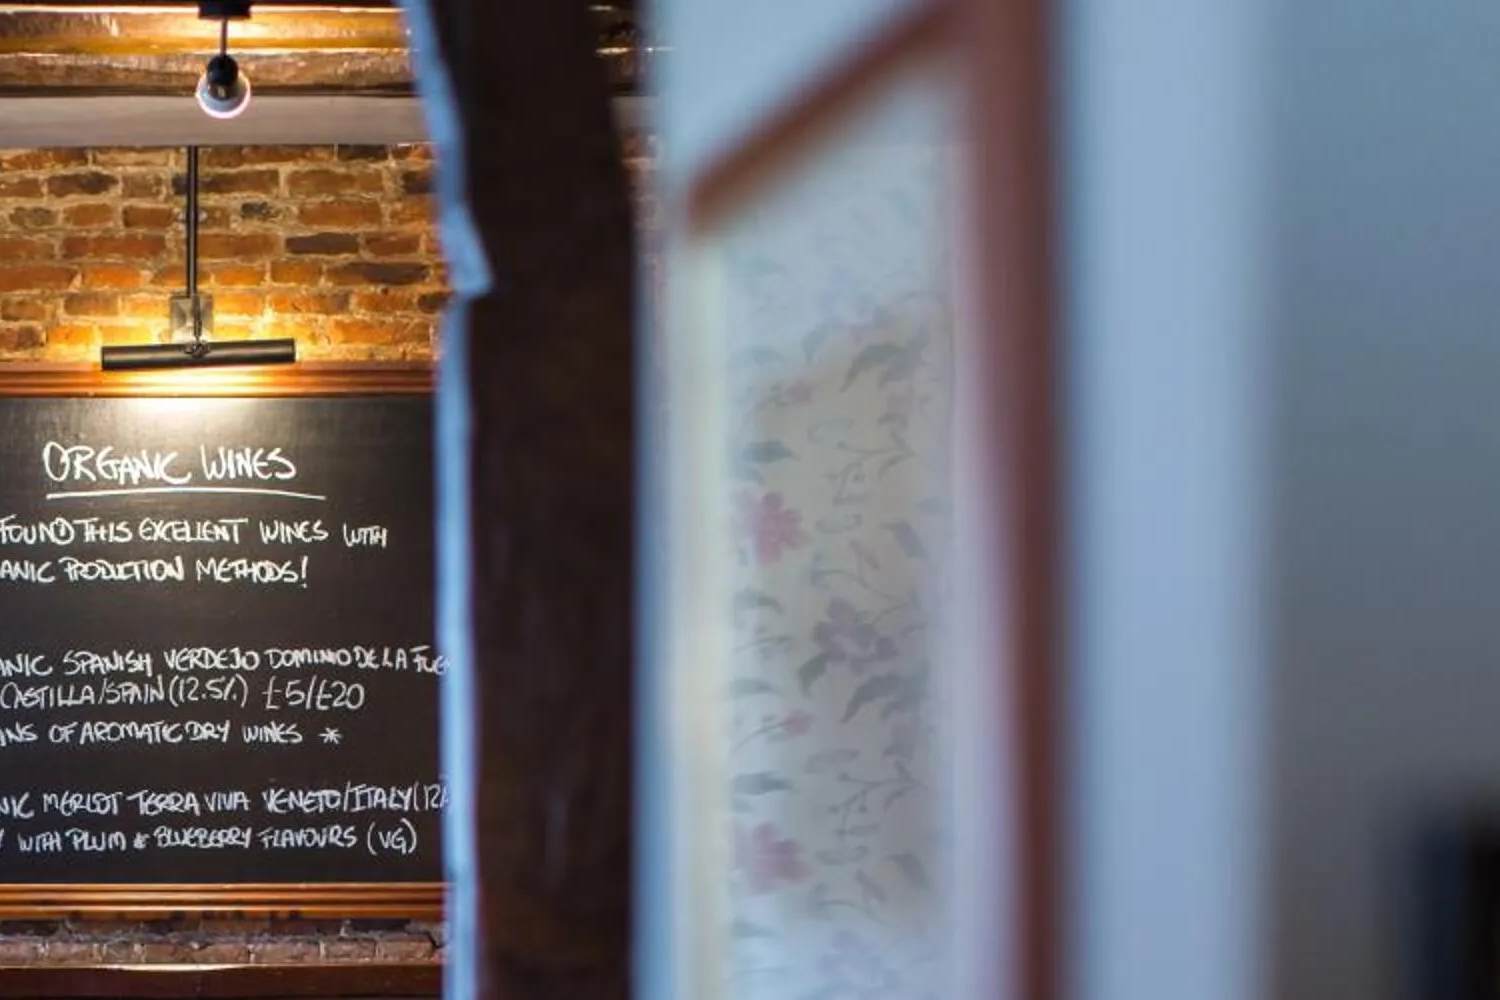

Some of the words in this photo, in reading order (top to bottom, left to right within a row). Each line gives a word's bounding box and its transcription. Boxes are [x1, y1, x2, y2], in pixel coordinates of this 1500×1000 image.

[43, 441, 193, 485] ORGANIC
[200, 444, 297, 480] WINES
[73, 517, 133, 544] THIS
[259, 519, 329, 545] WINES
[342, 523, 389, 548] WITH
[196, 555, 310, 589] METHODS!
[63, 649, 153, 677] SPANISH
[164, 646, 261, 671] VERDEJO
[352, 646, 380, 669] DE
[381, 646, 408, 671] LA
[261, 674, 366, 711] £5/£20
[49, 721, 79, 743] OF
[80, 720, 184, 745] AROMATIC
[185, 720, 231, 743] DRY
[242, 721, 303, 744] WINES
[43, 790, 123, 817] MERLOT
[126, 789, 201, 817] TERRA
[204, 791, 252, 812] VIVA
[17, 832, 62, 853] WITH
[64, 828, 127, 851] PLUM
[152, 825, 253, 849] BLUEBERRY
[256, 825, 358, 850] FLAVOURS
[367, 817, 419, 856] (VG)
